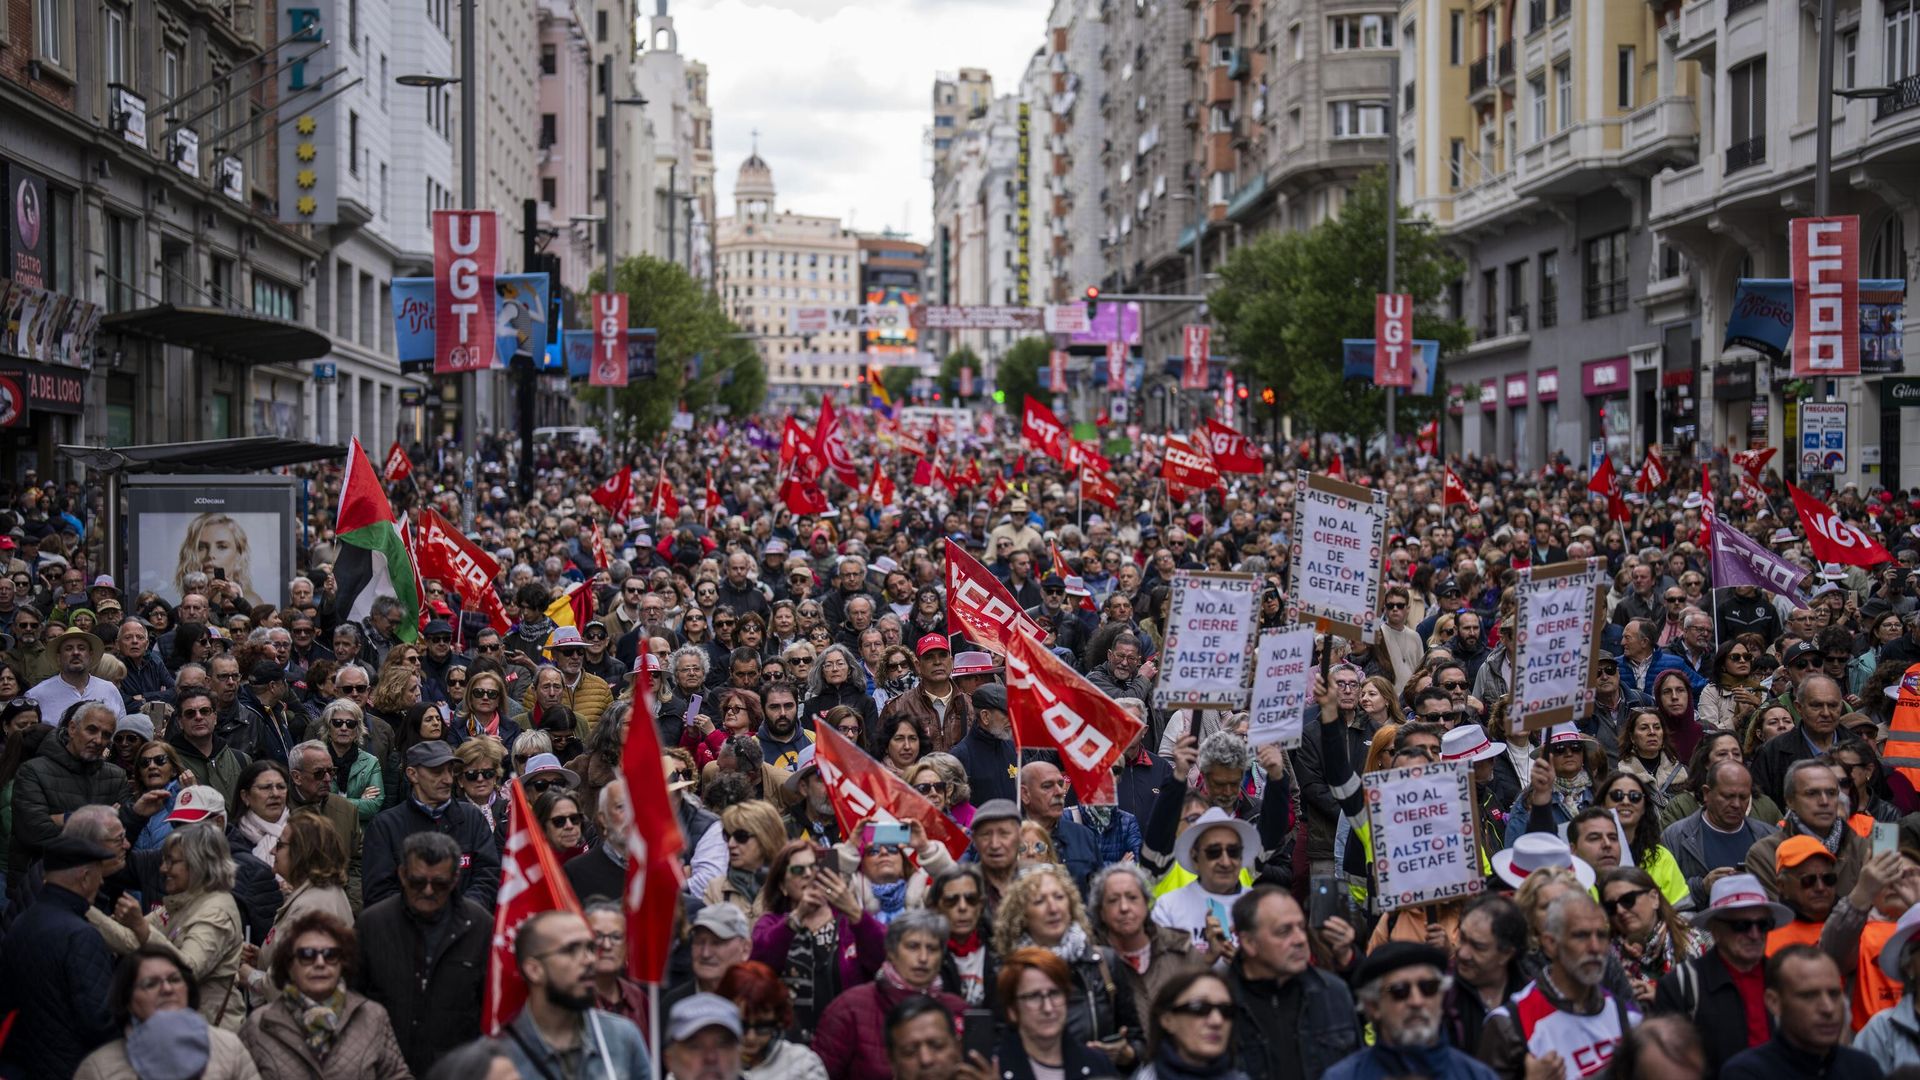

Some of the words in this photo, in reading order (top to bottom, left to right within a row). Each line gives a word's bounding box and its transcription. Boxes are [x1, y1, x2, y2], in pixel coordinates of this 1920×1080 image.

[17, 252, 41, 274] TEATRO
[449, 215, 480, 344] UGT
[1808, 221, 1843, 369] CCOO
[601, 294, 619, 360] UGT
[1384, 295, 1403, 369] UGT
[28, 373, 38, 398] A
[40, 376, 56, 399] DEL
[57, 378, 81, 404] LORO
[194, 497, 225, 505] JCDecaux
[1308, 490, 1357, 512] ALSTOM
[1318, 515, 1337, 529] NO
[1341, 520, 1358, 533] AL
[1292, 511, 1304, 566] ALSTOM
[1313, 531, 1361, 549] CIERRE
[1370, 513, 1383, 569] ALSTOM
[1327, 550, 1344, 563] DE
[1308, 561, 1365, 582] ALSTOM
[1309, 576, 1360, 596] GETAFE
[1195, 602, 1216, 614] NO
[1219, 603, 1236, 615] AL
[1541, 603, 1559, 618] NO
[1562, 601, 1577, 613] AL
[1582, 586, 1594, 646] ALSTOM
[1188, 619, 1238, 631] CIERRE
[1517, 596, 1528, 655] ALSTOM
[1536, 616, 1579, 636] CIERRE
[1202, 636, 1221, 648] DE
[1549, 636, 1566, 650] DE
[1162, 625, 1179, 682] ALSTOM
[1179, 651, 1240, 664] ALSTOM
[1272, 649, 1287, 660] NO
[1289, 647, 1302, 659] AL
[1528, 648, 1581, 669] ALSTOM
[1180, 667, 1234, 679] GETAFE
[1266, 661, 1304, 678] CIERRE
[1529, 664, 1577, 684] GETAFE
[1155, 690, 1209, 702] ALSTOM
[1277, 680, 1291, 692] DE
[1007, 649, 1112, 771] COO
[1257, 692, 1304, 709] ALSTOM
[1257, 707, 1299, 724] GETAFE
[1400, 762, 1457, 779] ALSTOM
[1396, 791, 1418, 806] NO
[1422, 787, 1442, 801] AL
[1393, 803, 1449, 824] CIERRE
[1413, 823, 1432, 837] DE
[1393, 834, 1458, 858] ALSTOM
[1461, 812, 1477, 870] ALSTOM
[1374, 824, 1389, 883] ALSTOM
[1397, 851, 1457, 873] GETAFE
[1572, 1036, 1622, 1070] CC
